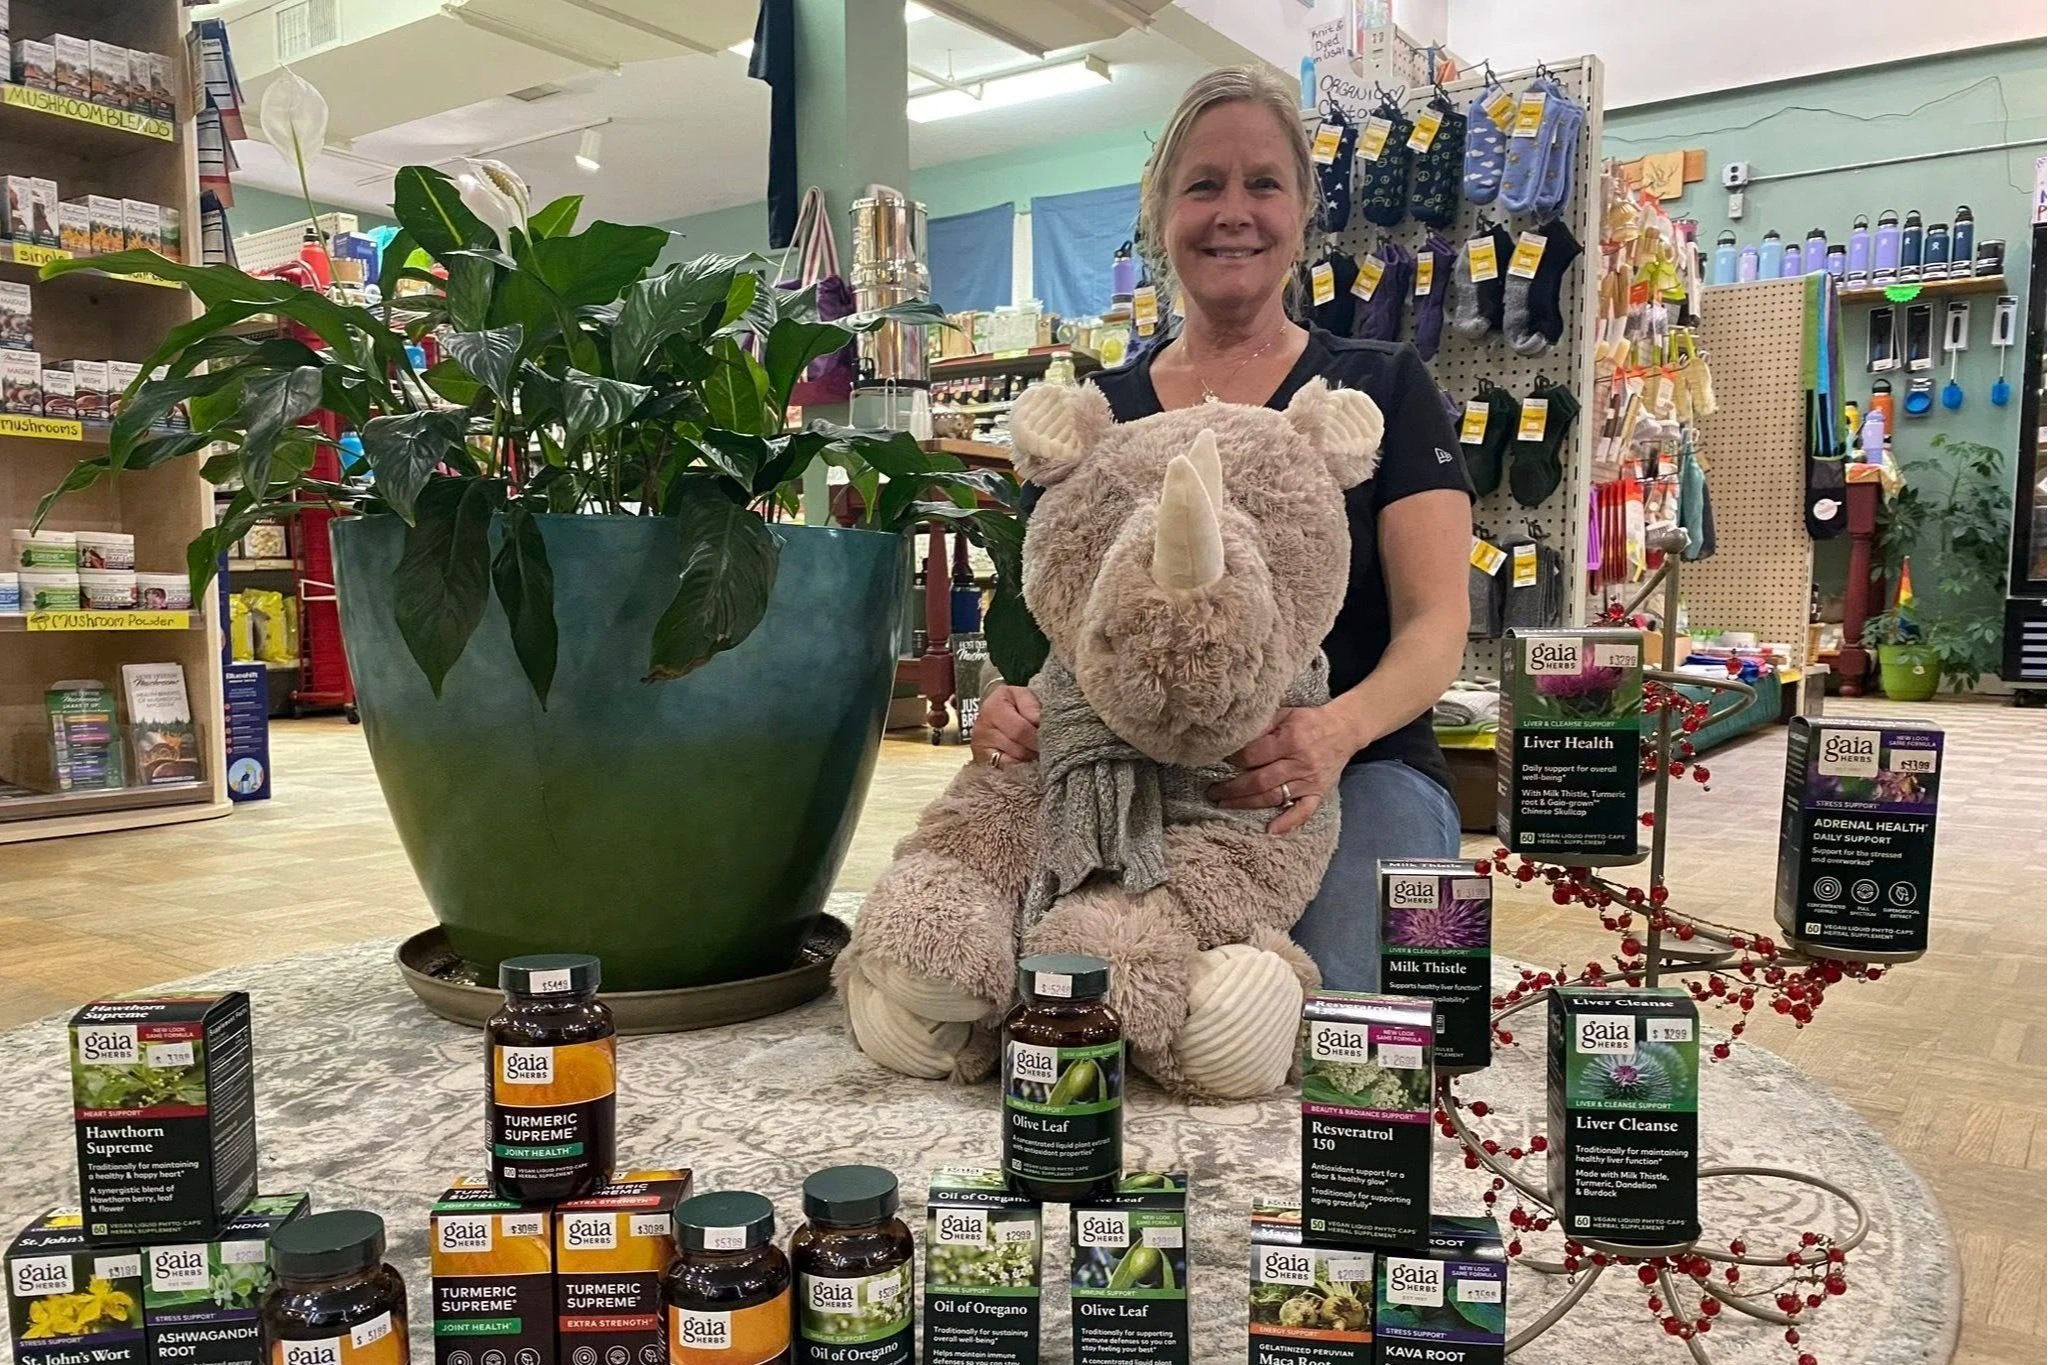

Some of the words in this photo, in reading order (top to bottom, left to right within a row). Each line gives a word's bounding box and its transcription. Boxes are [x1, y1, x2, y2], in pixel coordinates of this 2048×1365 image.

[1315, 34, 1339, 51] Dyed
[1531, 644, 1576, 670] gaia
[1524, 737, 1561, 749] Liver
[1565, 737, 1614, 749] Health
[1824, 735, 1873, 763] gaia
[1522, 765, 1543, 773] Daily
[1544, 765, 1575, 773] support
[1577, 765, 1589, 773] for
[1562, 790, 1589, 799] Thistle,
[1814, 819, 1873, 831] ADRENAL
[1813, 833, 1842, 842] DAILY
[1844, 835, 1891, 844] SUPPORT
[1394, 881, 1433, 903] gaia
[1390, 962, 1419, 972] Milk
[1422, 962, 1467, 974] Thistle
[91, 1004, 165, 1012] Hawthorn
[83, 1011, 149, 1020] Supreme
[1582, 1021, 1630, 1048] gaia
[84, 1032, 133, 1060] gaia
[1317, 1029, 1363, 1055] gaia
[1598, 1041, 1628, 1049] HERBS
[1333, 1049, 1361, 1057] HERBS
[507, 1053, 548, 1080] gaia
[1016, 1050, 1052, 1075] gaia
[1027, 1069, 1051, 1078] HERBS
[505, 1113, 577, 1126] TURMERIC
[1013, 1114, 1039, 1130] Olive
[1042, 1119, 1070, 1133] Leaf
[1576, 1117, 1616, 1130] Liver
[1619, 1118, 1678, 1132] Cleanse
[85, 1126, 164, 1139] Hawthorn
[1312, 1122, 1393, 1141] Resveratrol
[86, 1142, 153, 1157] Supreme
[1312, 1139, 1335, 1150] 150
[505, 1148, 529, 1156] JOINT
[1576, 1146, 1625, 1156] Traditionally
[1627, 1147, 1639, 1155] for
[1641, 1148, 1689, 1158] maintaining
[88, 1162, 136, 1170] Traditionally
[152, 1160, 199, 1170] maintaining
[1576, 1170, 1598, 1178] Made
[1601, 1170, 1618, 1178] with
[1621, 1171, 1638, 1179] Milk
[1640, 1172, 1669, 1181] Thistle,
[1576, 1179, 1614, 1188] Turmeric,
[1616, 1181, 1657, 1189] Dandelion
[1311, 1187, 1357, 1199] Traditionally
[1358, 1191, 1370, 1199] for
[1371, 1193, 1411, 1205] supporting
[569, 1220, 611, 1245] gaia
[638, 1224, 664, 1235] $3099
[941, 1215, 983, 1240] gaia
[1083, 1218, 1124, 1242] gaia
[444, 1222, 487, 1248] gaia
[1006, 1231, 1031, 1240] $2999
[156, 1252, 203, 1279] gaia
[1265, 1253, 1310, 1278] gaia
[19, 1264, 67, 1291] gaia
[1280, 1272, 1308, 1280] HERBS
[1391, 1265, 1439, 1291] gaia
[441, 1286, 516, 1298] TURMERIC
[566, 1284, 641, 1295] TURMERIC
[813, 1282, 853, 1307] gaia
[1407, 1284, 1436, 1293] HERBS
[934, 1301, 954, 1313] Oil
[958, 1302, 972, 1313] of
[973, 1303, 1028, 1318] Oregano
[1081, 1304, 1116, 1315] Olive
[1119, 1305, 1149, 1317] Leaf
[442, 1324, 469, 1332] JOINT
[683, 1318, 725, 1343] gaia
[934, 1326, 978, 1336] Traditionally
[992, 1329, 1028, 1337] sustaining
[1082, 1328, 1124, 1336] Traditionally
[157, 1328, 259, 1344] ASHWAGANDH
[697, 1336, 725, 1344] HERBS
[22, 1357, 37, 1365] St.
[46, 1352, 89, 1365] John's
[92, 1349, 130, 1360] Wort
[159, 1346, 196, 1357] ROOT
[288, 1347, 335, 1365] gaia
[811, 1346, 828, 1359] Oil
[832, 1348, 846, 1361] of
[847, 1341, 898, 1363] Oregano
[1259, 1344, 1311, 1355] GELATINIZED
[1313, 1348, 1354, 1357] PERUVIAN
[1386, 1346, 1423, 1359] KAVA
[1426, 1351, 1465, 1362] ROOT
[1260, 1354, 1294, 1365] Maca
